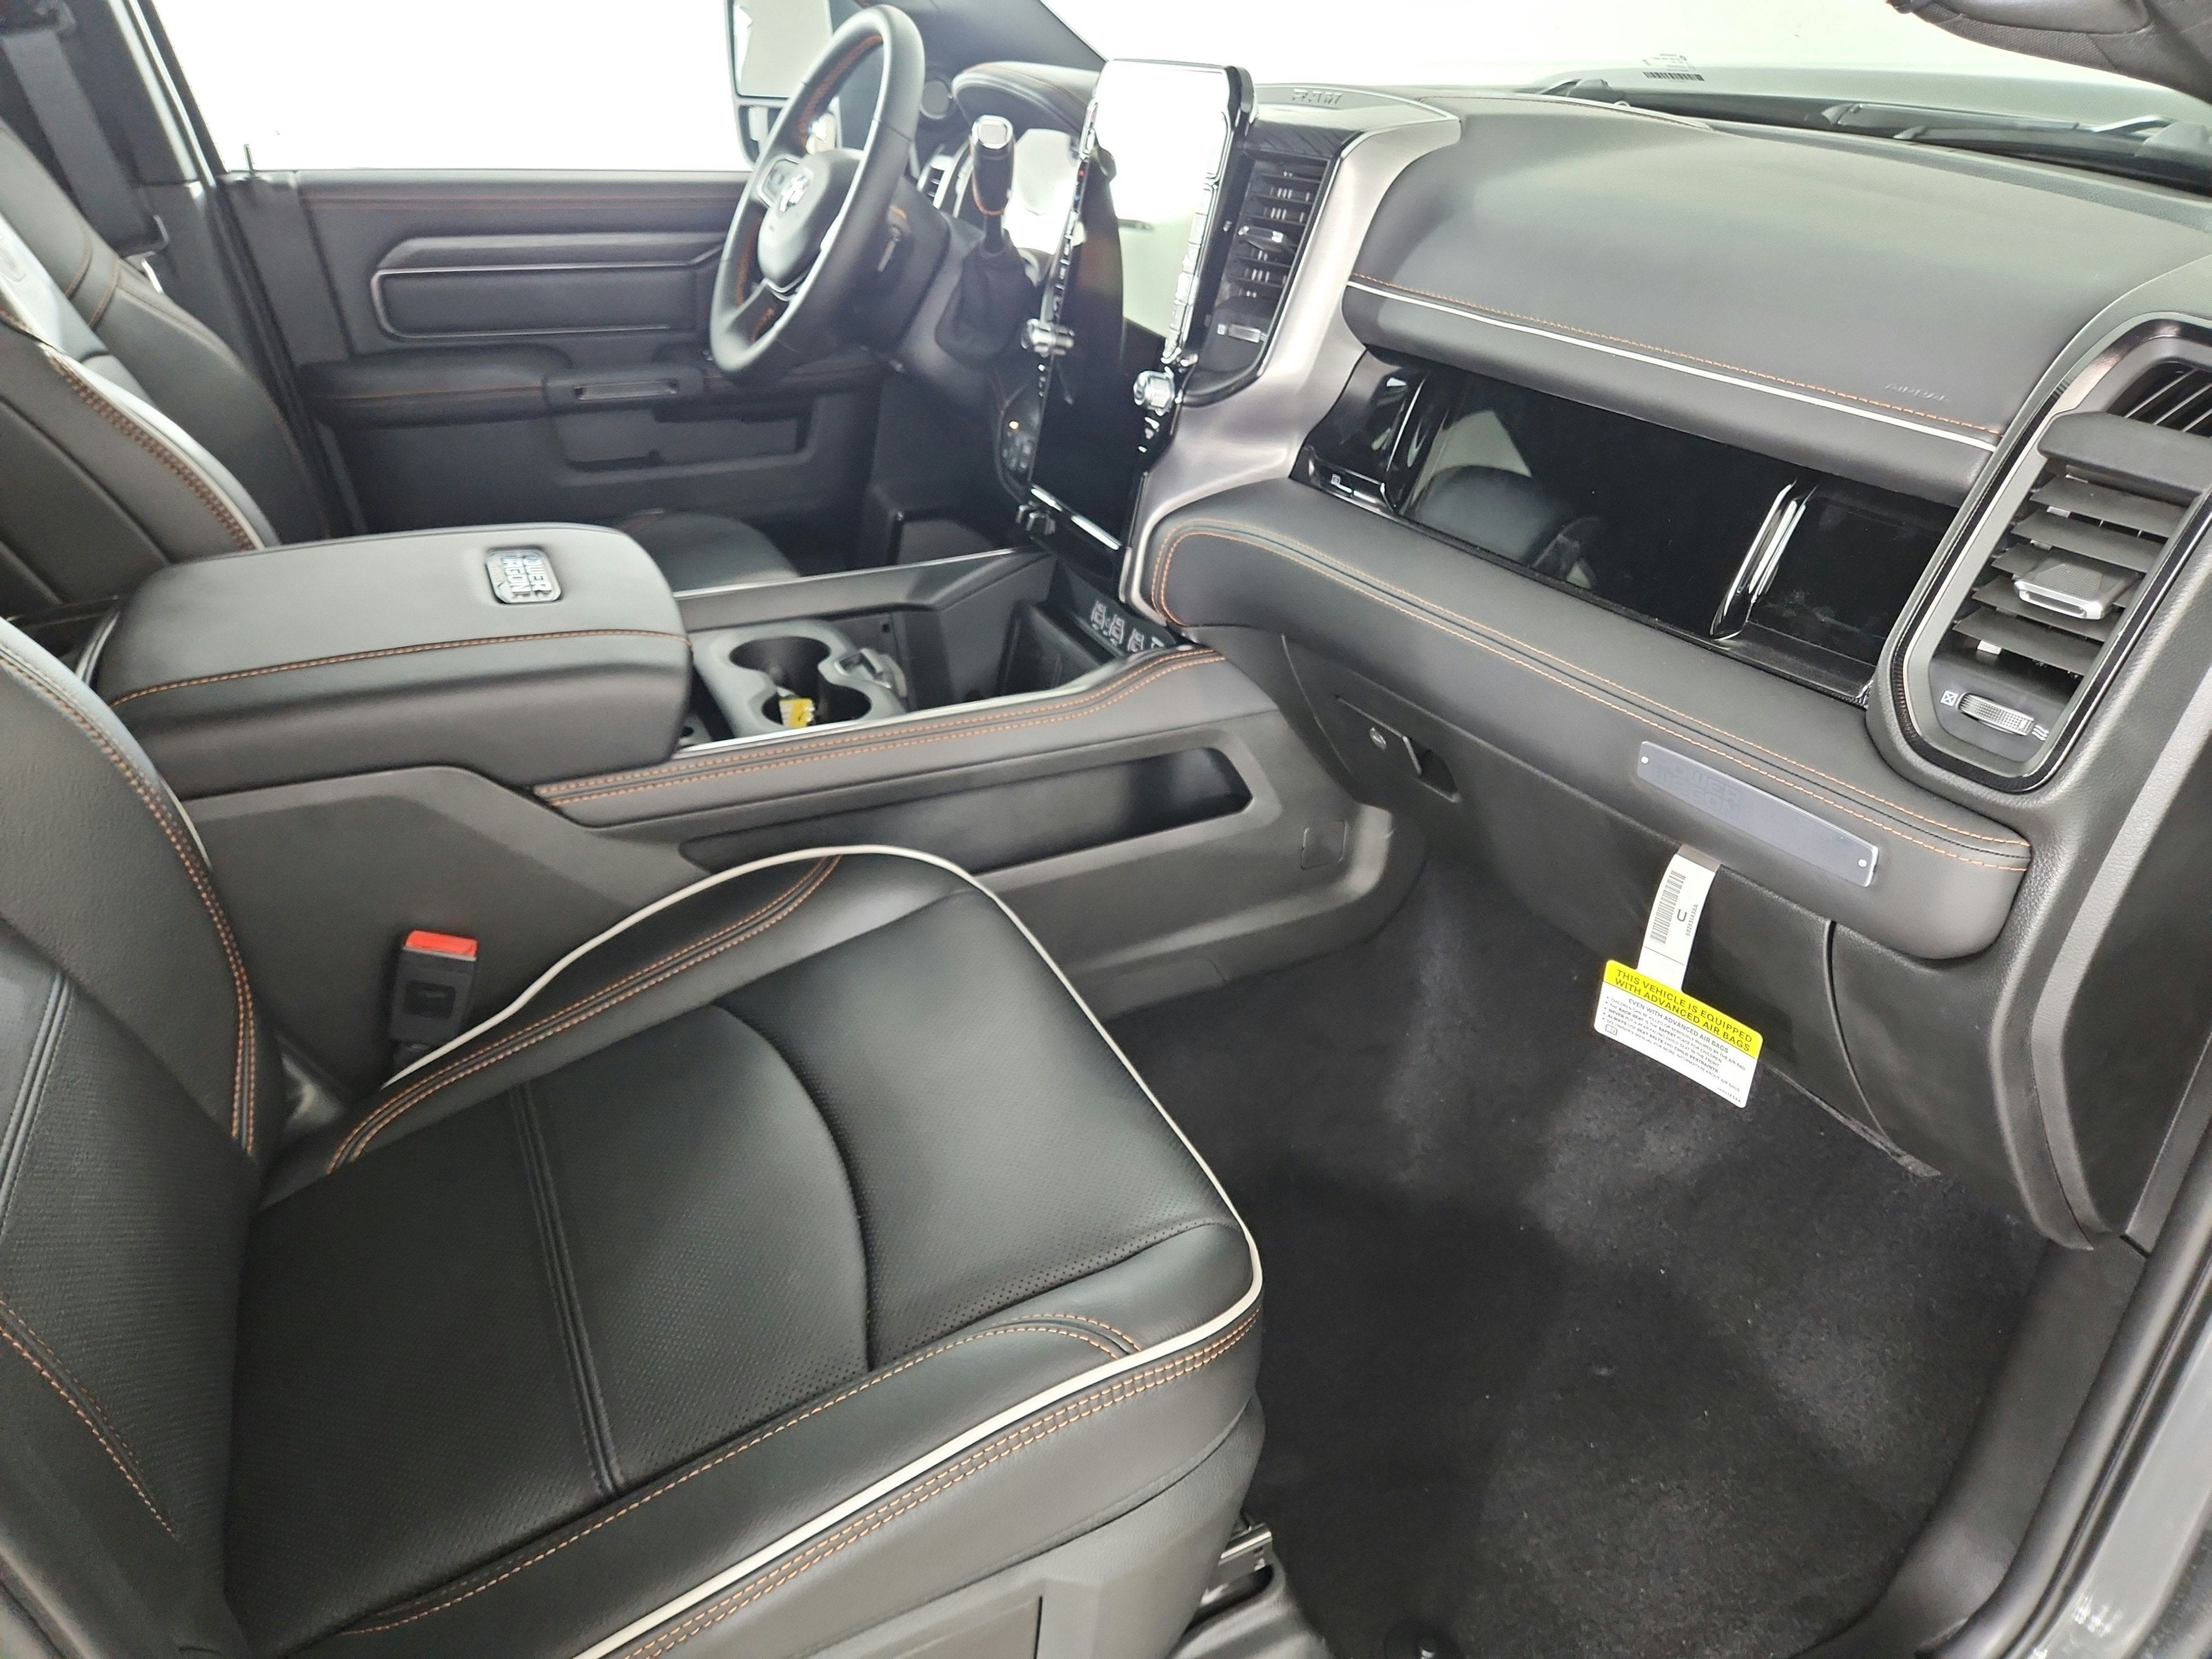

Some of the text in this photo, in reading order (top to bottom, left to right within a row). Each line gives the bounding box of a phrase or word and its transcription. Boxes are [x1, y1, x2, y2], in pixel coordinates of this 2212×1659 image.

[1292, 88, 1342, 104] RAM
[523, 556, 552, 591] OWER
[1651, 765, 1741, 821] WAGON
[1677, 909, 1688, 922] U
[1615, 978, 1750, 1052] WITH ADVANCED AIR BAGS
[1616, 969, 1752, 1043] THIS VEHICLE IS EQUIPPED
[1628, 998, 1729, 1054] EVEN WITH ADVANCED AIR BAGS
